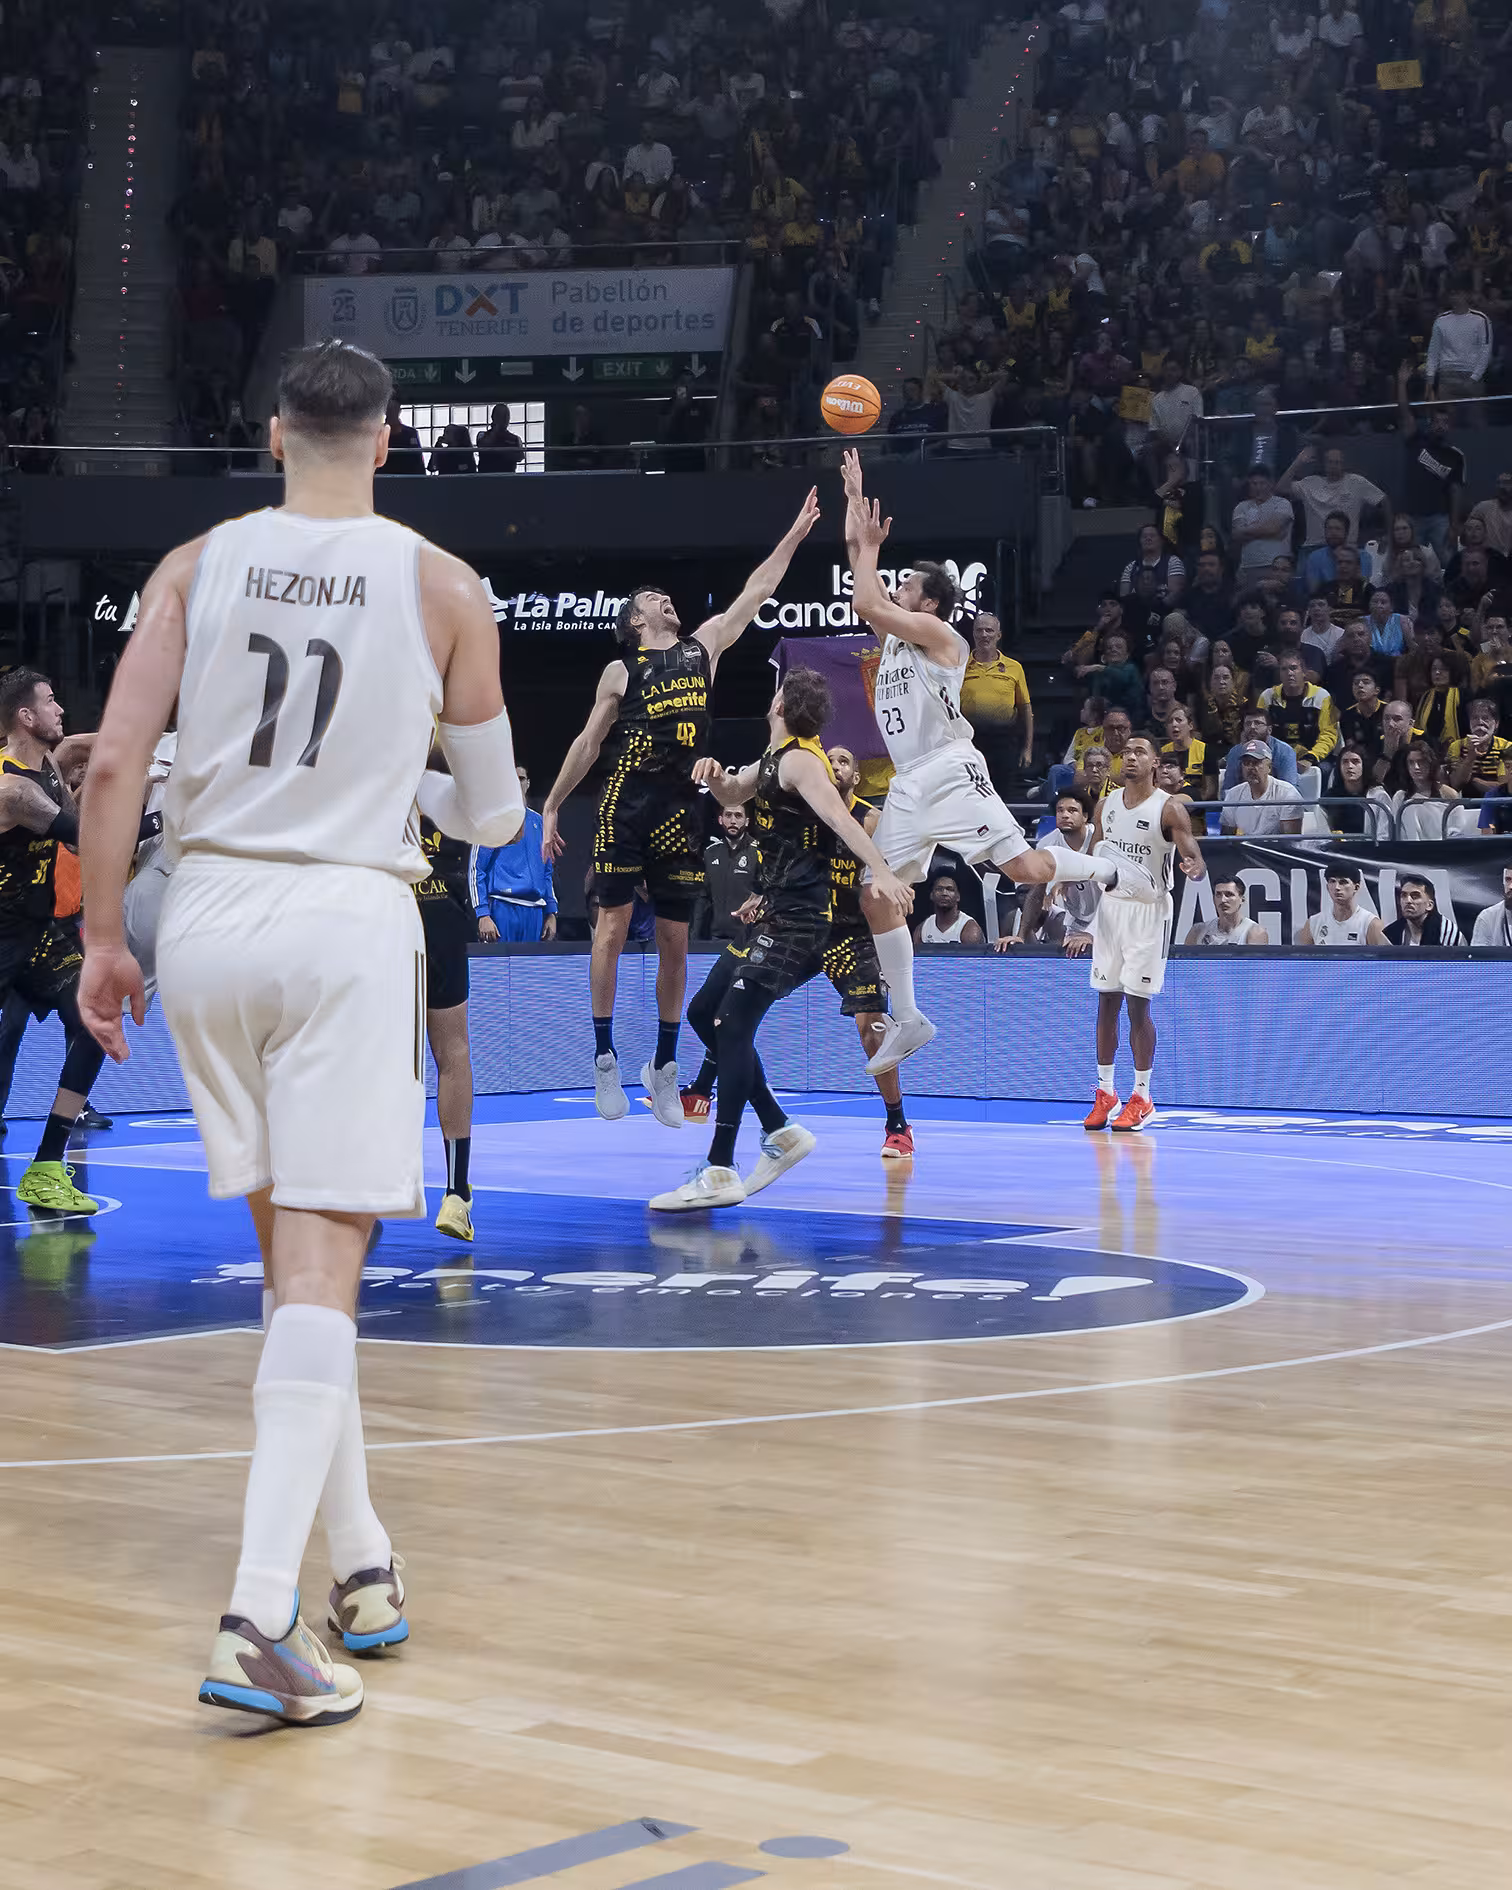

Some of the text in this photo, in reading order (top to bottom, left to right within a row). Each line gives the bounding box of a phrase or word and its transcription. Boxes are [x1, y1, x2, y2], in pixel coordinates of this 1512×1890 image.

[435, 283, 529, 317] DXT
[552, 279, 668, 304] Pabellón
[435, 319, 529, 336] TENERIFE
[553, 308, 716, 336] de deportes
[603, 361, 643, 376] EXIT
[245, 566, 367, 607] HEZONJA
[832, 564, 916, 595] Isa
[94, 594, 118, 621] tu
[514, 593, 551, 618] La
[753, 597, 870, 629] Cana
[513, 621, 527, 631] La
[531, 621, 552, 631] Isla
[556, 621, 594, 631] Bonita
[248, 632, 344, 768] 11
[641, 676, 706, 700] LA LAGUN
[882, 707, 905, 735] 23
[676, 722, 697, 747] 42
[1104, 837, 1152, 856] irates
[830, 858, 857, 870] UNA
[191, 1277, 1008, 1301] deierta emociones
